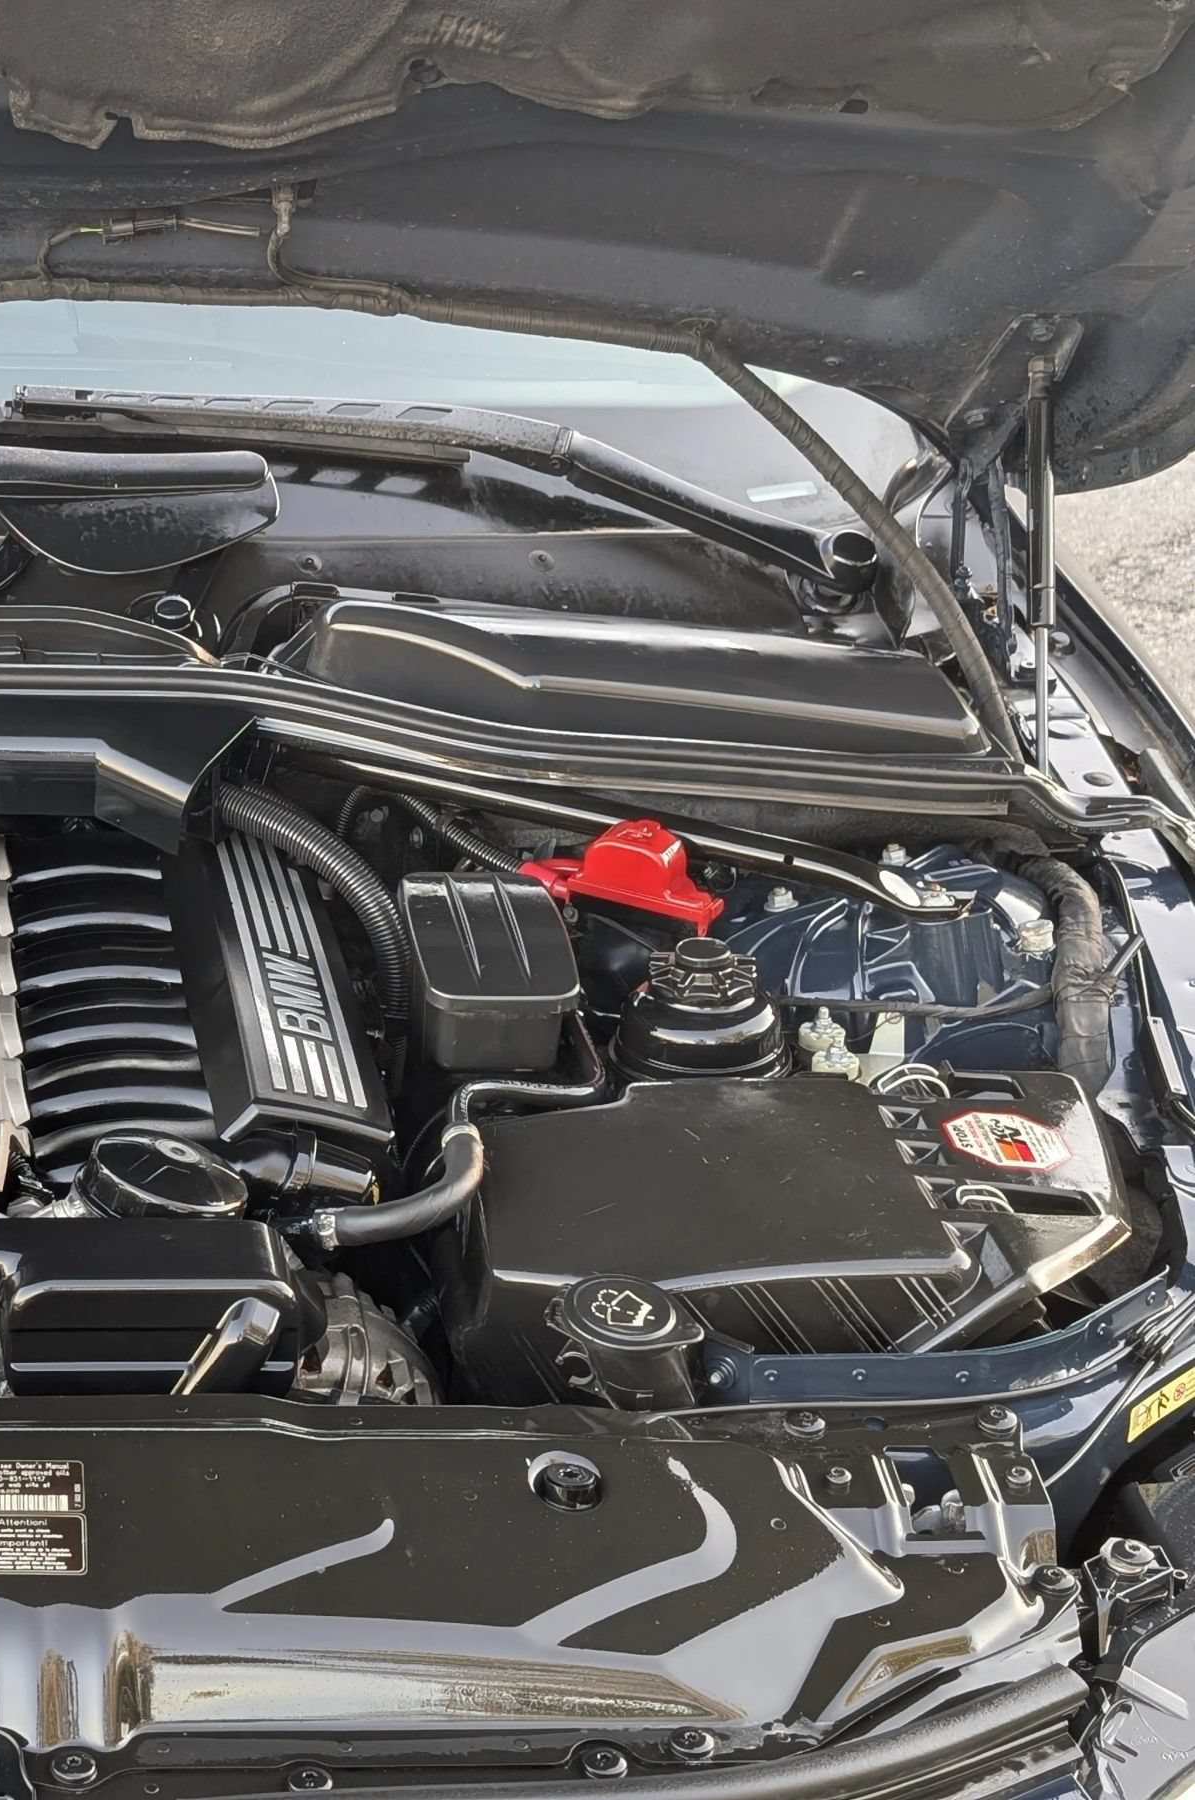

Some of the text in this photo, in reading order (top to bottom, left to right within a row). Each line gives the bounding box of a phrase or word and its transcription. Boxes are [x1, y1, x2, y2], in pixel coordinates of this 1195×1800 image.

[261, 950, 333, 1042] BMW
[950, 1124, 974, 1148] STOP!
[46, 1462, 69, 1470] Manual
